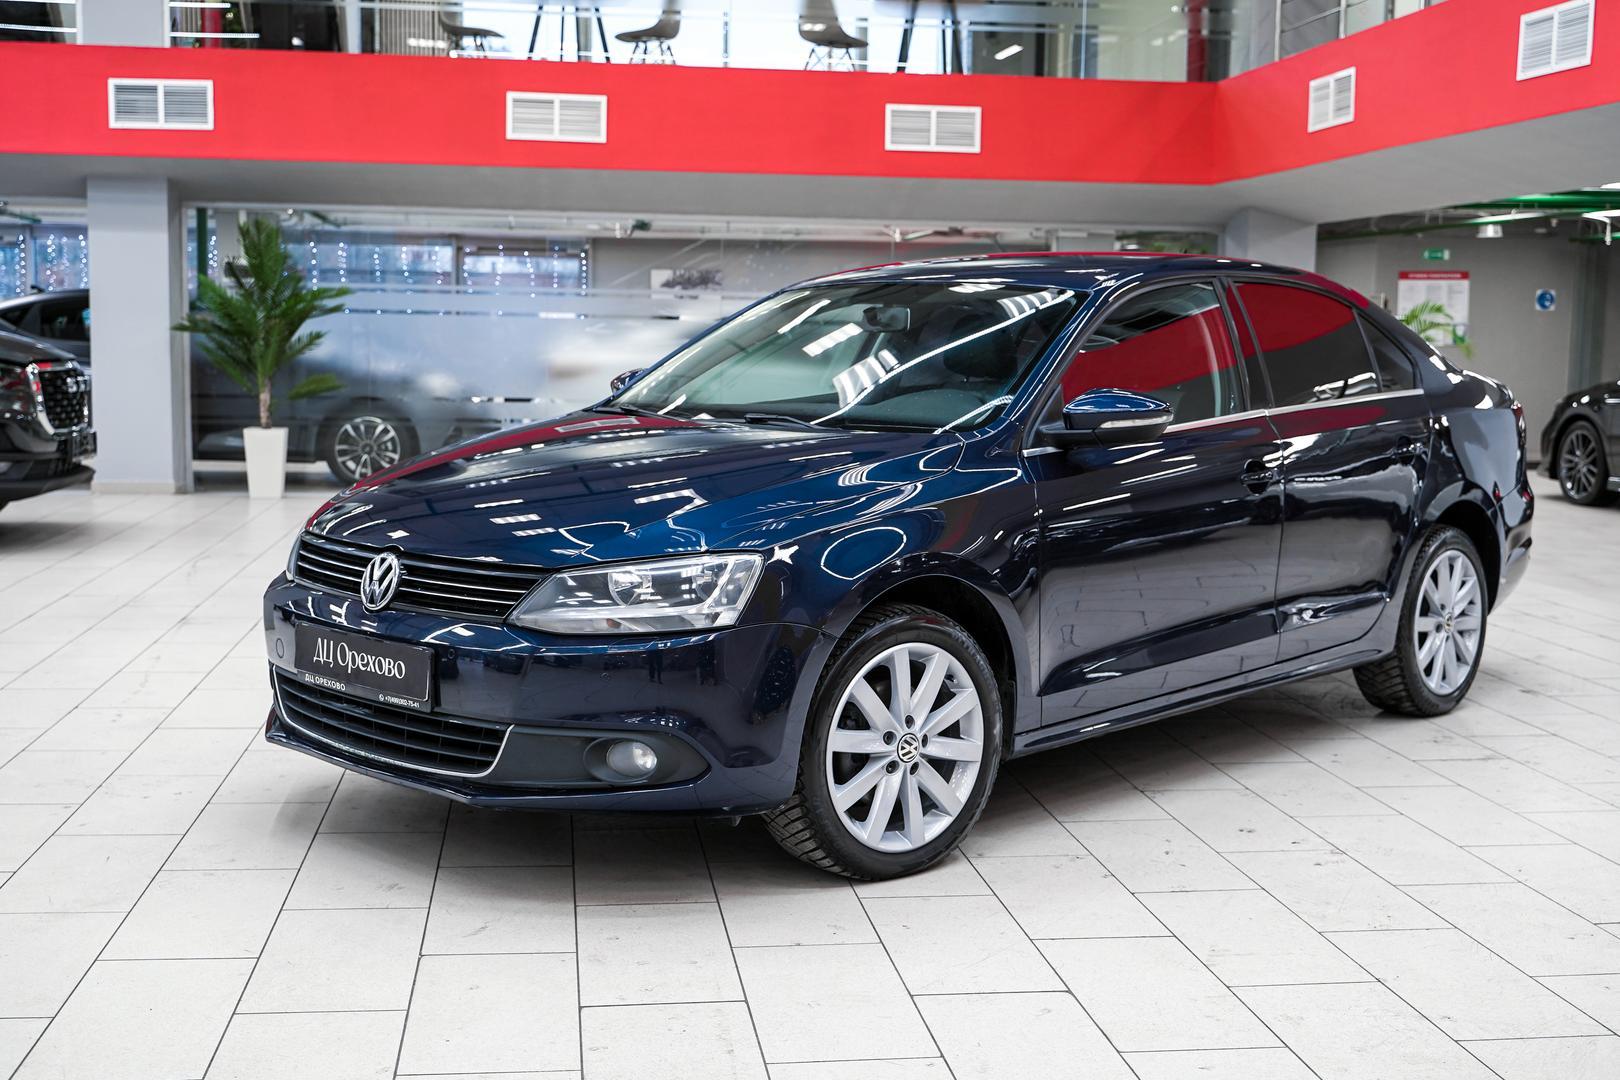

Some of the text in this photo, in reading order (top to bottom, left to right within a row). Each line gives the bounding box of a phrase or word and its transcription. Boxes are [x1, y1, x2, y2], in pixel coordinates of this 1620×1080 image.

[361, 552, 400, 610] VW
[313, 637, 406, 679] ДЦ Орехово
[304, 673, 346, 691] ДЦ ОРЕХОВО
